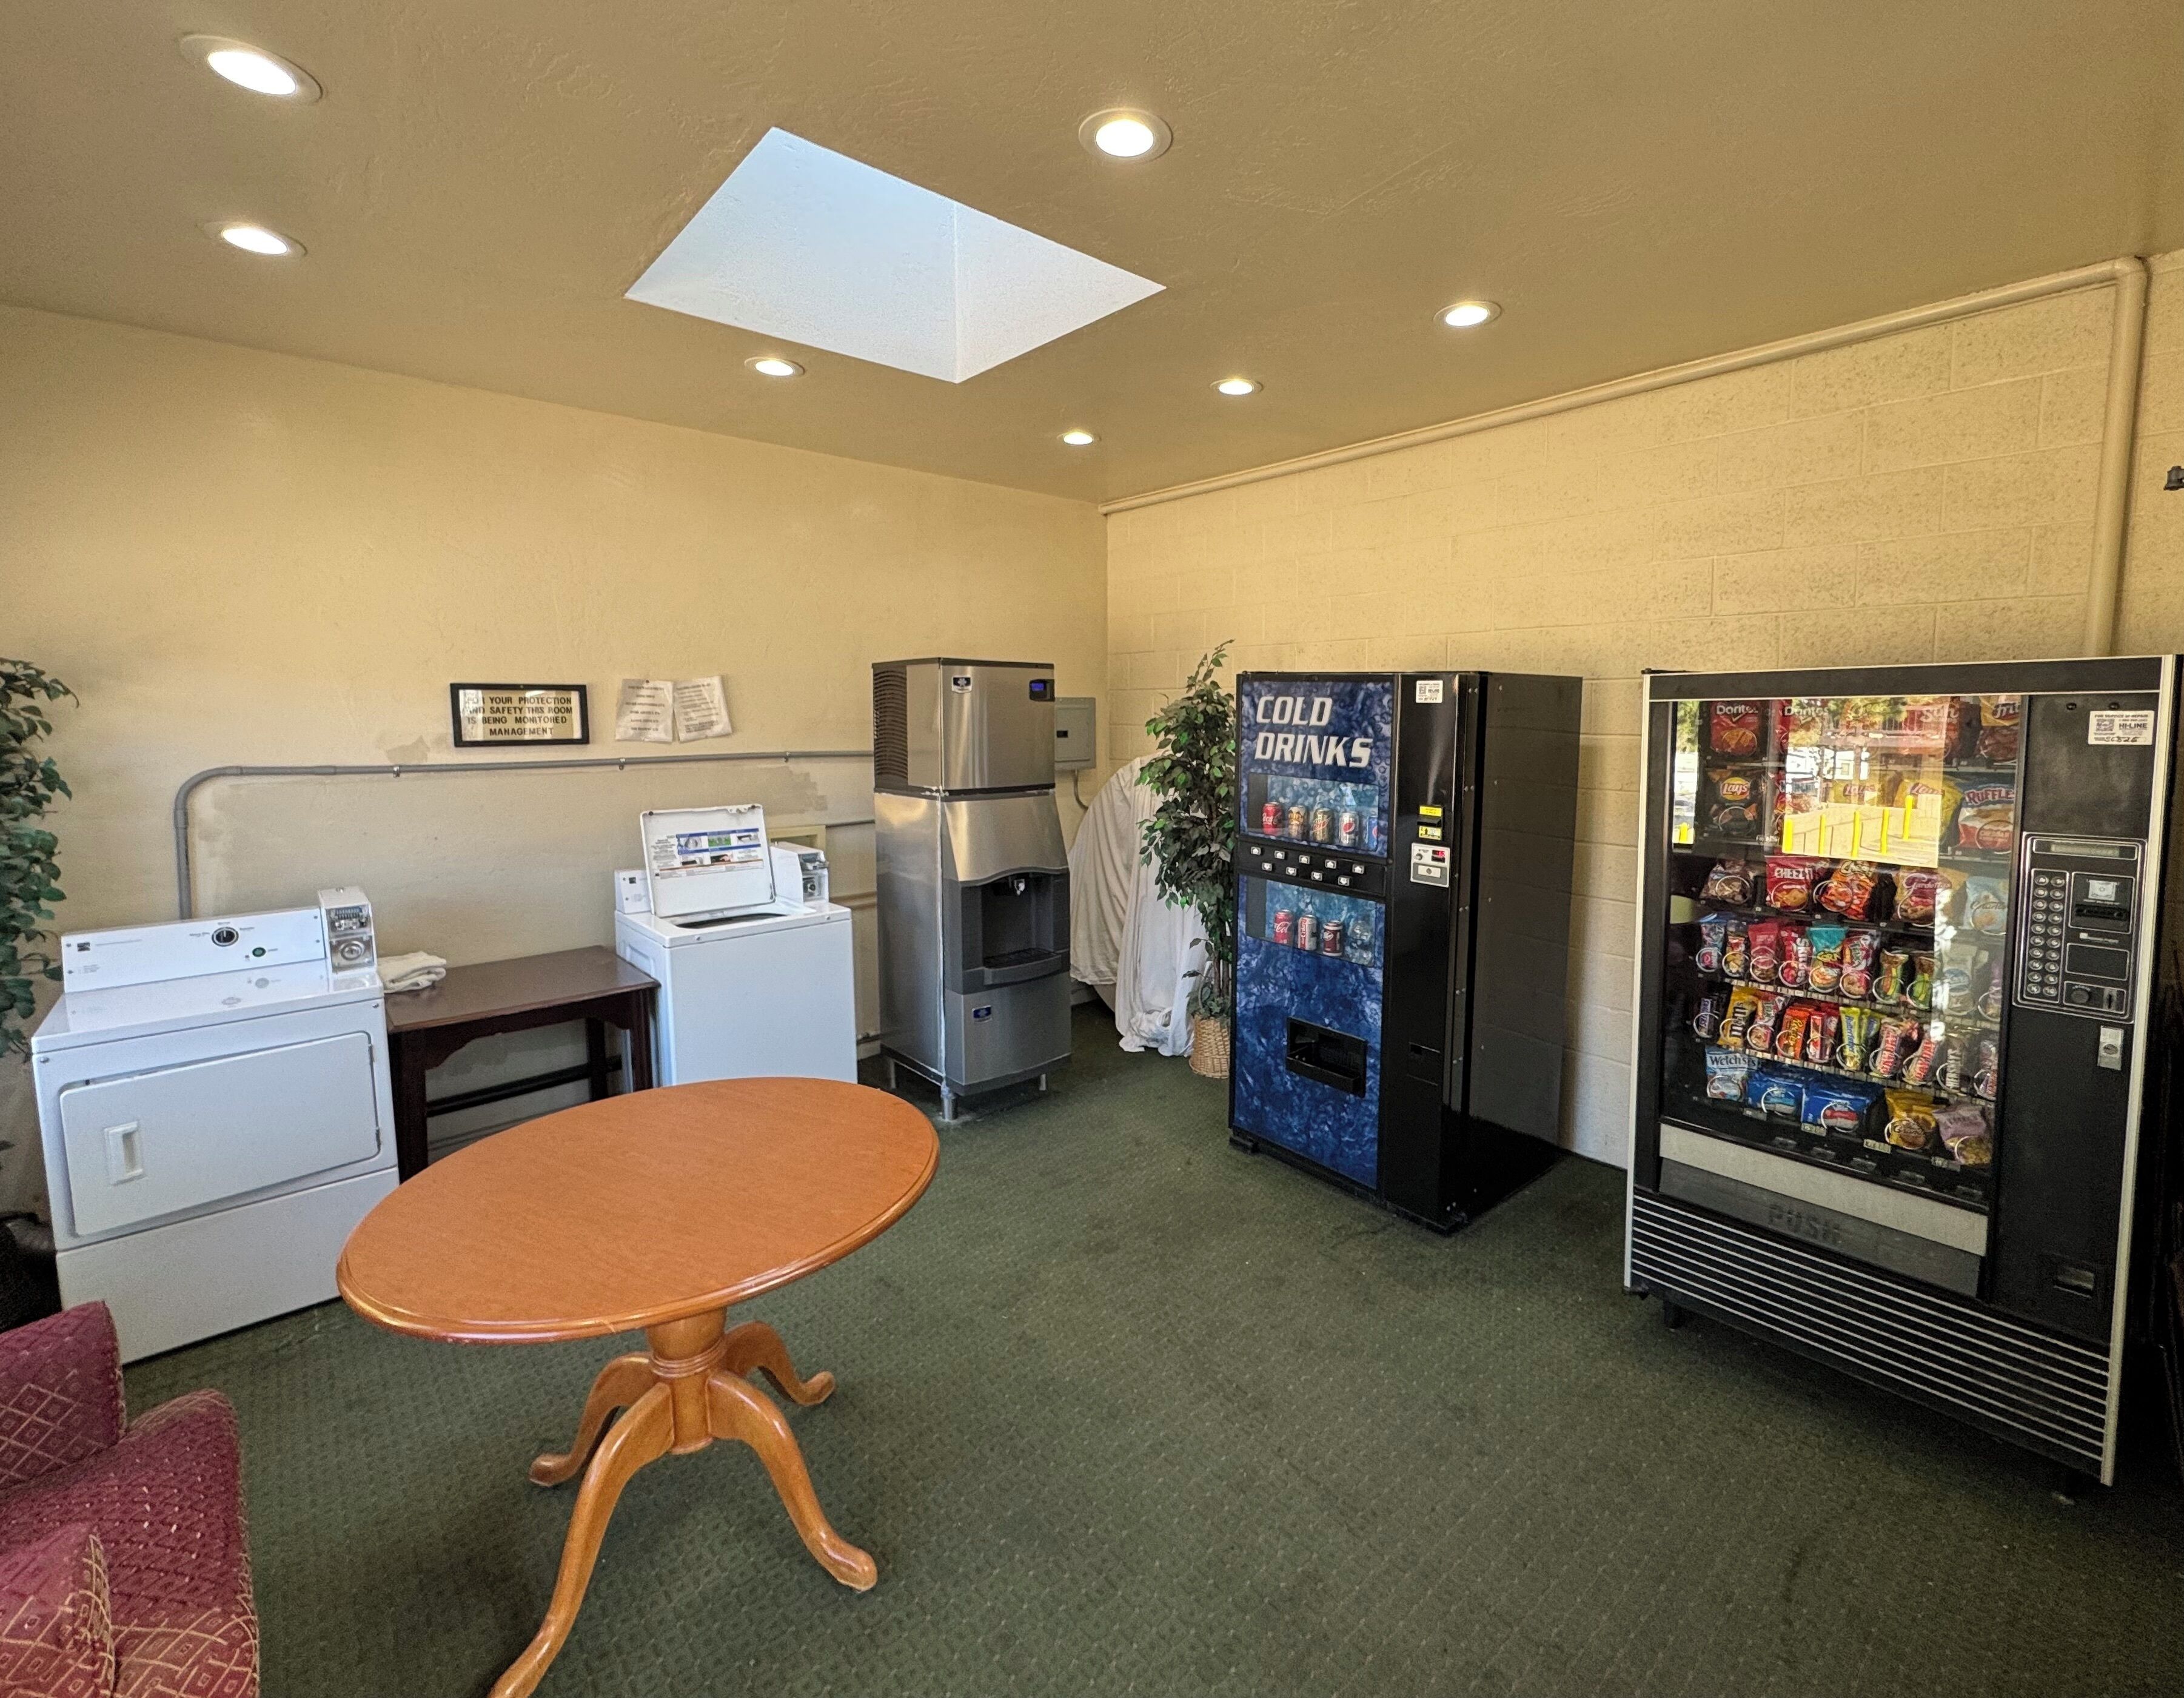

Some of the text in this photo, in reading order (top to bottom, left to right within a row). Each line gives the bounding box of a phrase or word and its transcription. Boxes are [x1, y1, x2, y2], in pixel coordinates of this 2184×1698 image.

[1256, 696, 1333, 727] COLD
[1717, 705, 1758, 714] Doritos
[489, 728, 554, 736] MANAGEMENT
[1254, 732, 1373, 768] DRINKS
[1796, 938, 1809, 983] Skittles
